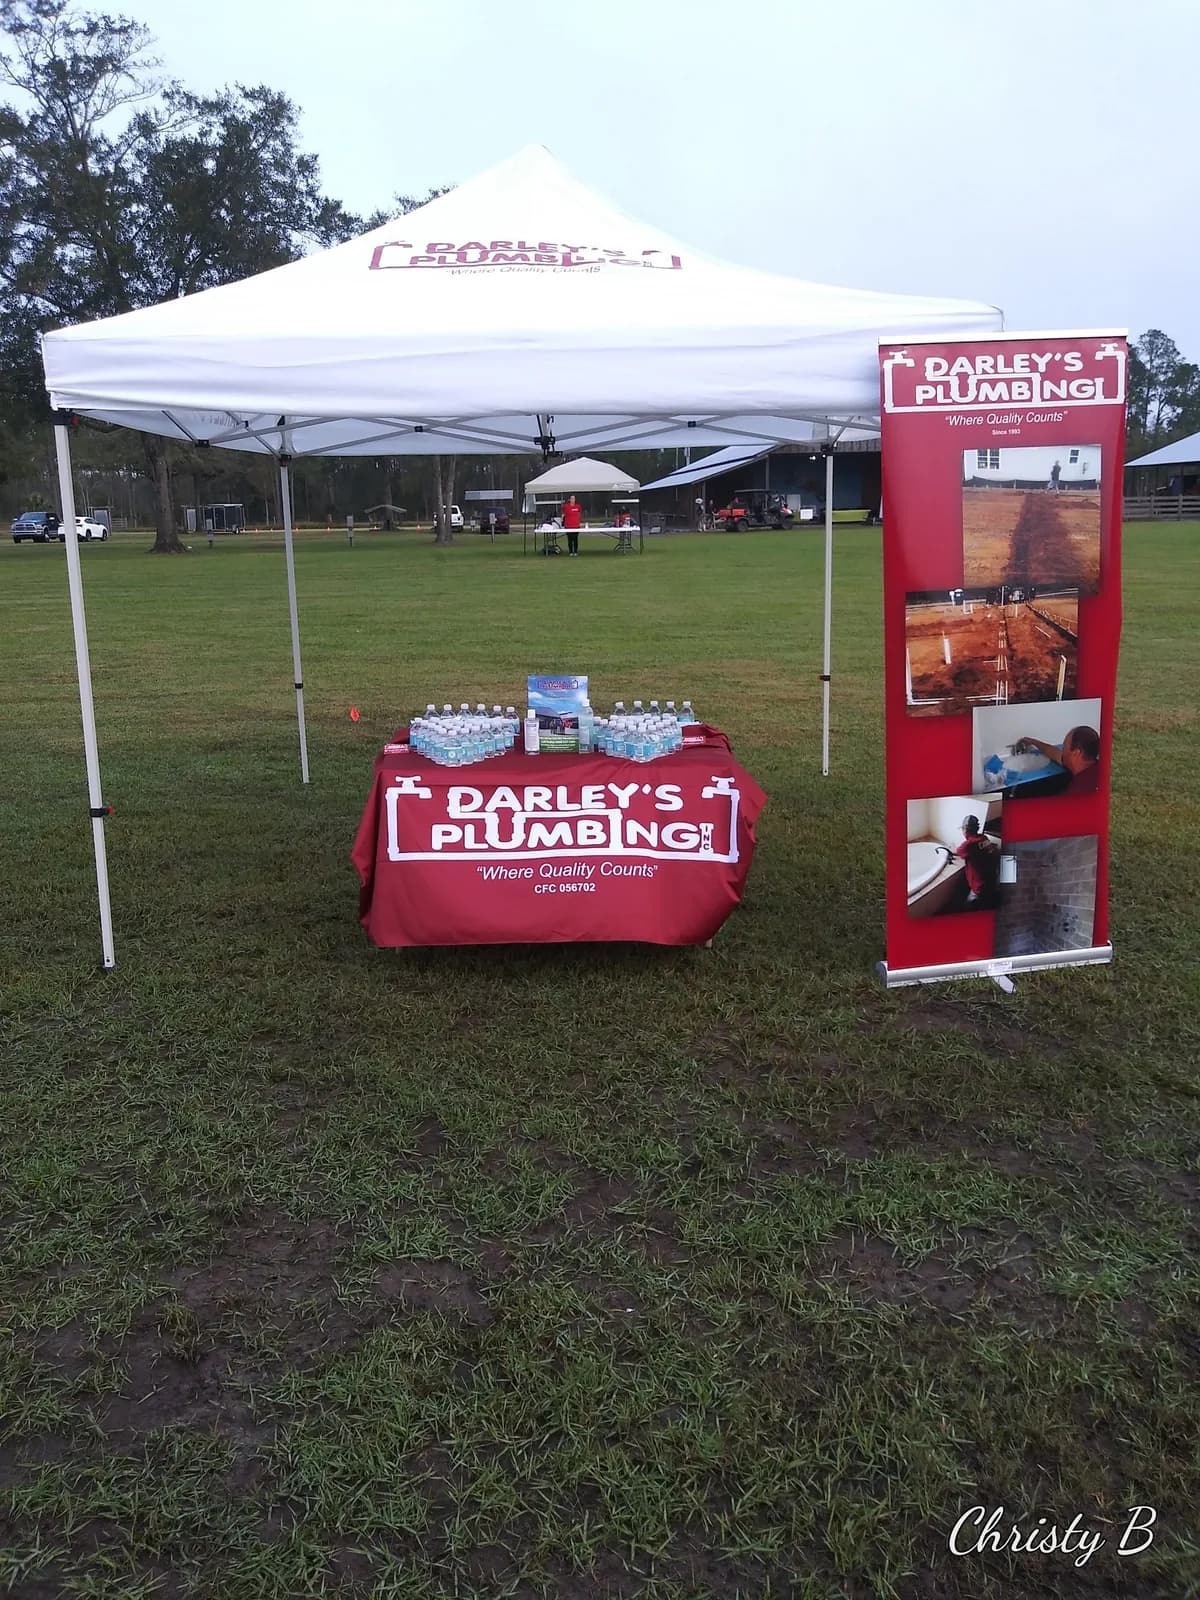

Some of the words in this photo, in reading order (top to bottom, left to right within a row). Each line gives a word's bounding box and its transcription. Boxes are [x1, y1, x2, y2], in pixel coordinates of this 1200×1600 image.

[925, 352, 1083, 379] DARLEY'S
[915, 375, 1095, 404] PLUMBING
[945, 413, 983, 427] "Where
[986, 411, 1024, 426] Quality
[1026, 410, 1068, 423] Counts"
[991, 428, 1007, 436] Since
[447, 783, 684, 815] DARLEY'S
[431, 812, 701, 850] PLUMBING
[476, 865, 534, 881] "Where
[539, 862, 595, 880] Quality
[600, 861, 658, 878] Counts"
[534, 884, 557, 894] CFC
[559, 882, 596, 893] 056702
